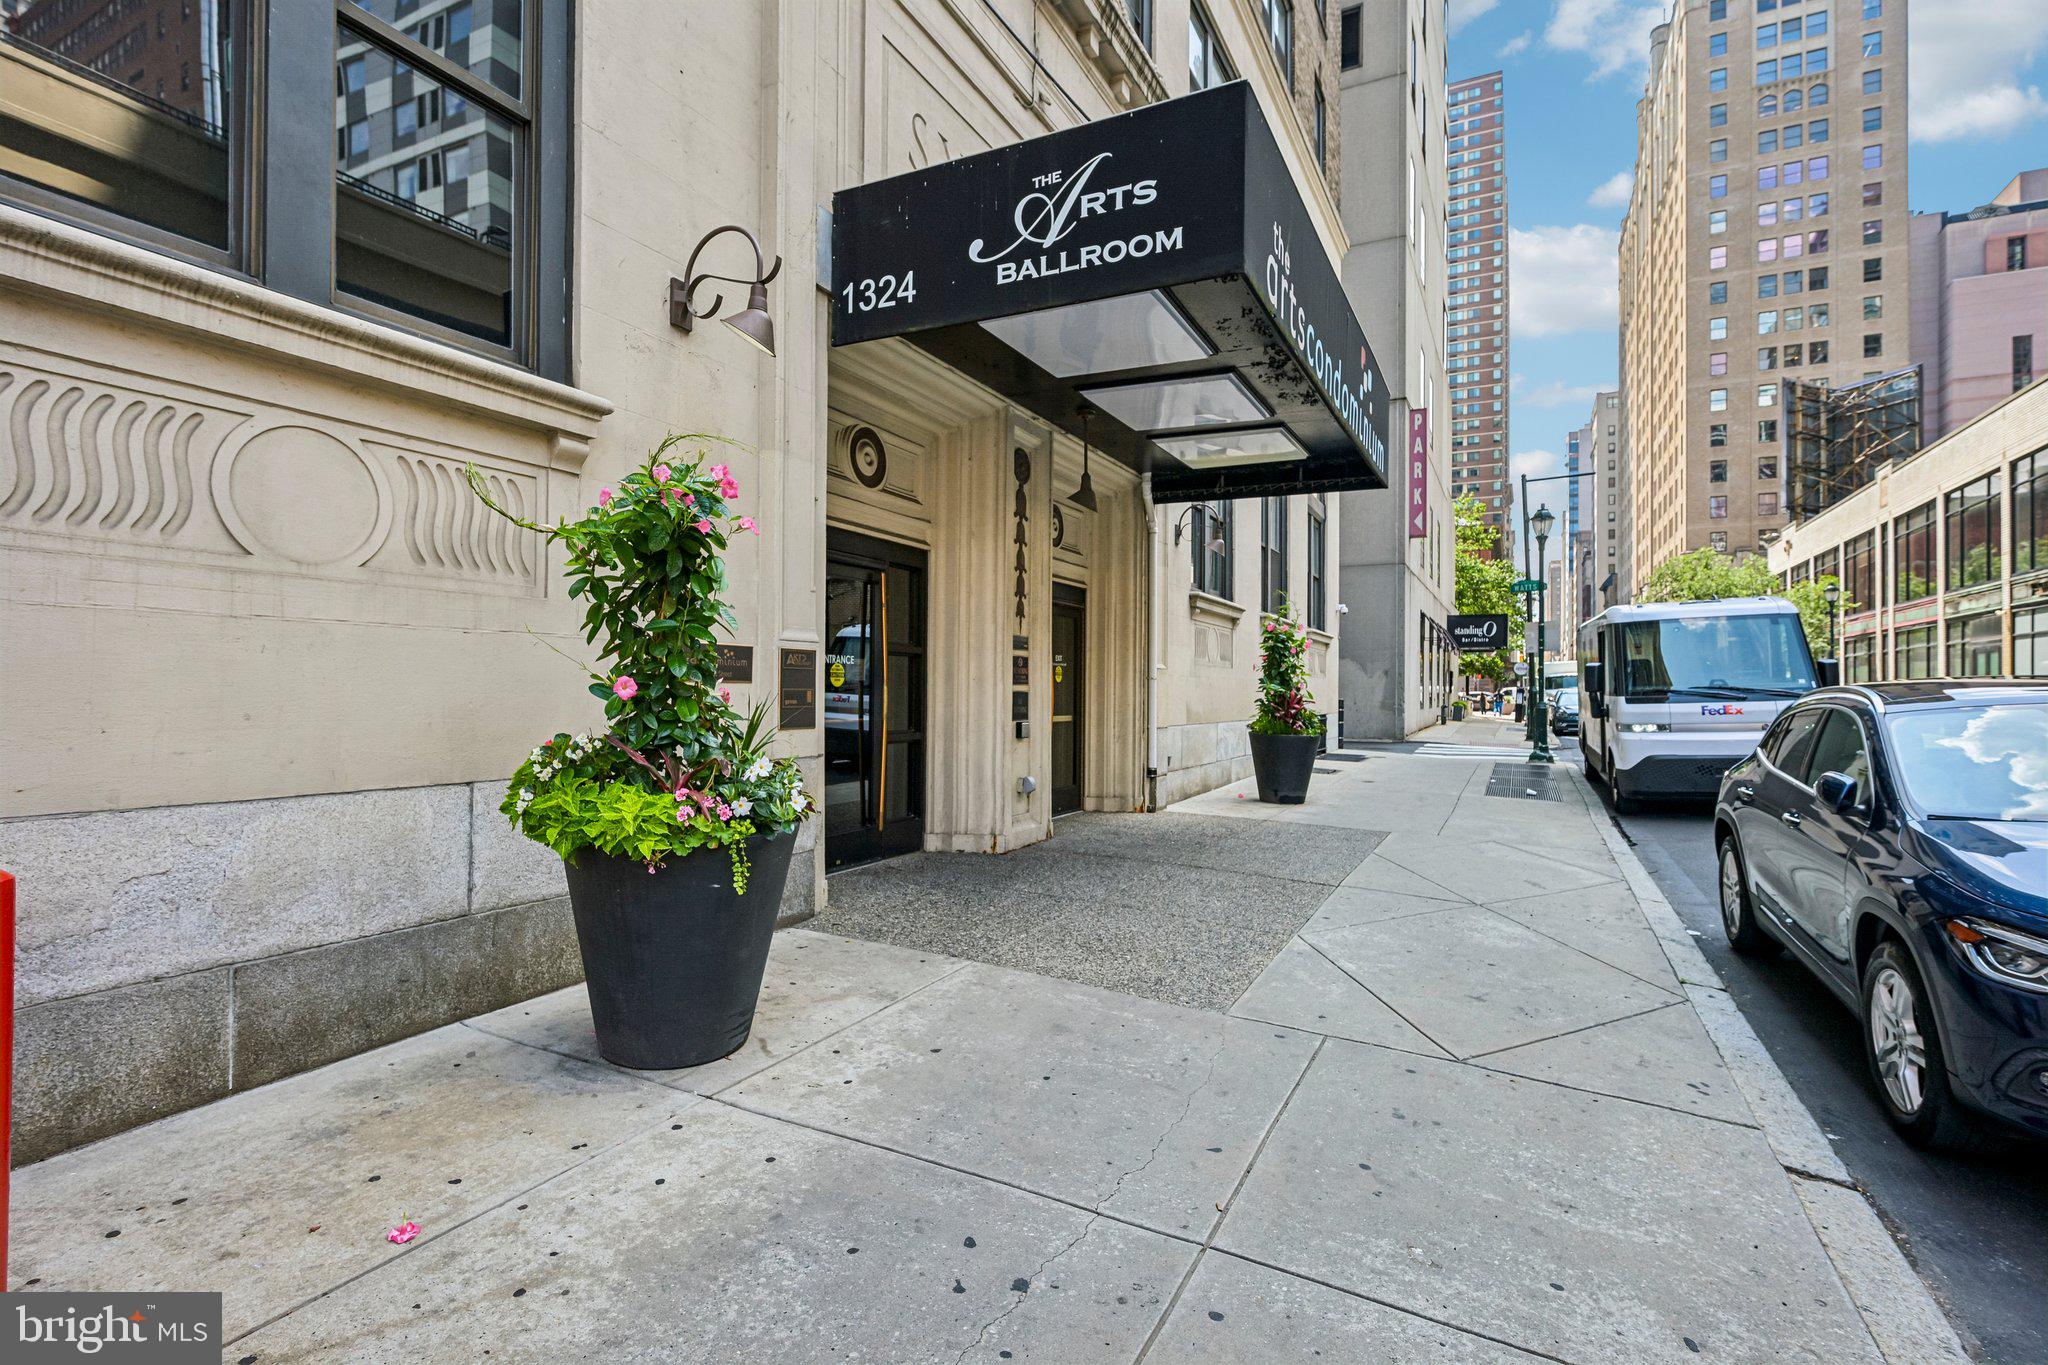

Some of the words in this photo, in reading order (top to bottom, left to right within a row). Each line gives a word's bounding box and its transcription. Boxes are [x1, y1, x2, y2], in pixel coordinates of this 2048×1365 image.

[1032, 170, 1062, 189] THE
[996, 226, 1183, 285] BALLROOM
[1273, 220, 1291, 275] the
[842, 270, 917, 314] 1324
[1413, 413, 1424, 505] PARK
[1513, 583, 1538, 592] WATTS
[825, 654, 855, 665] NTRANCE
[1701, 704, 1744, 715] FedEx
